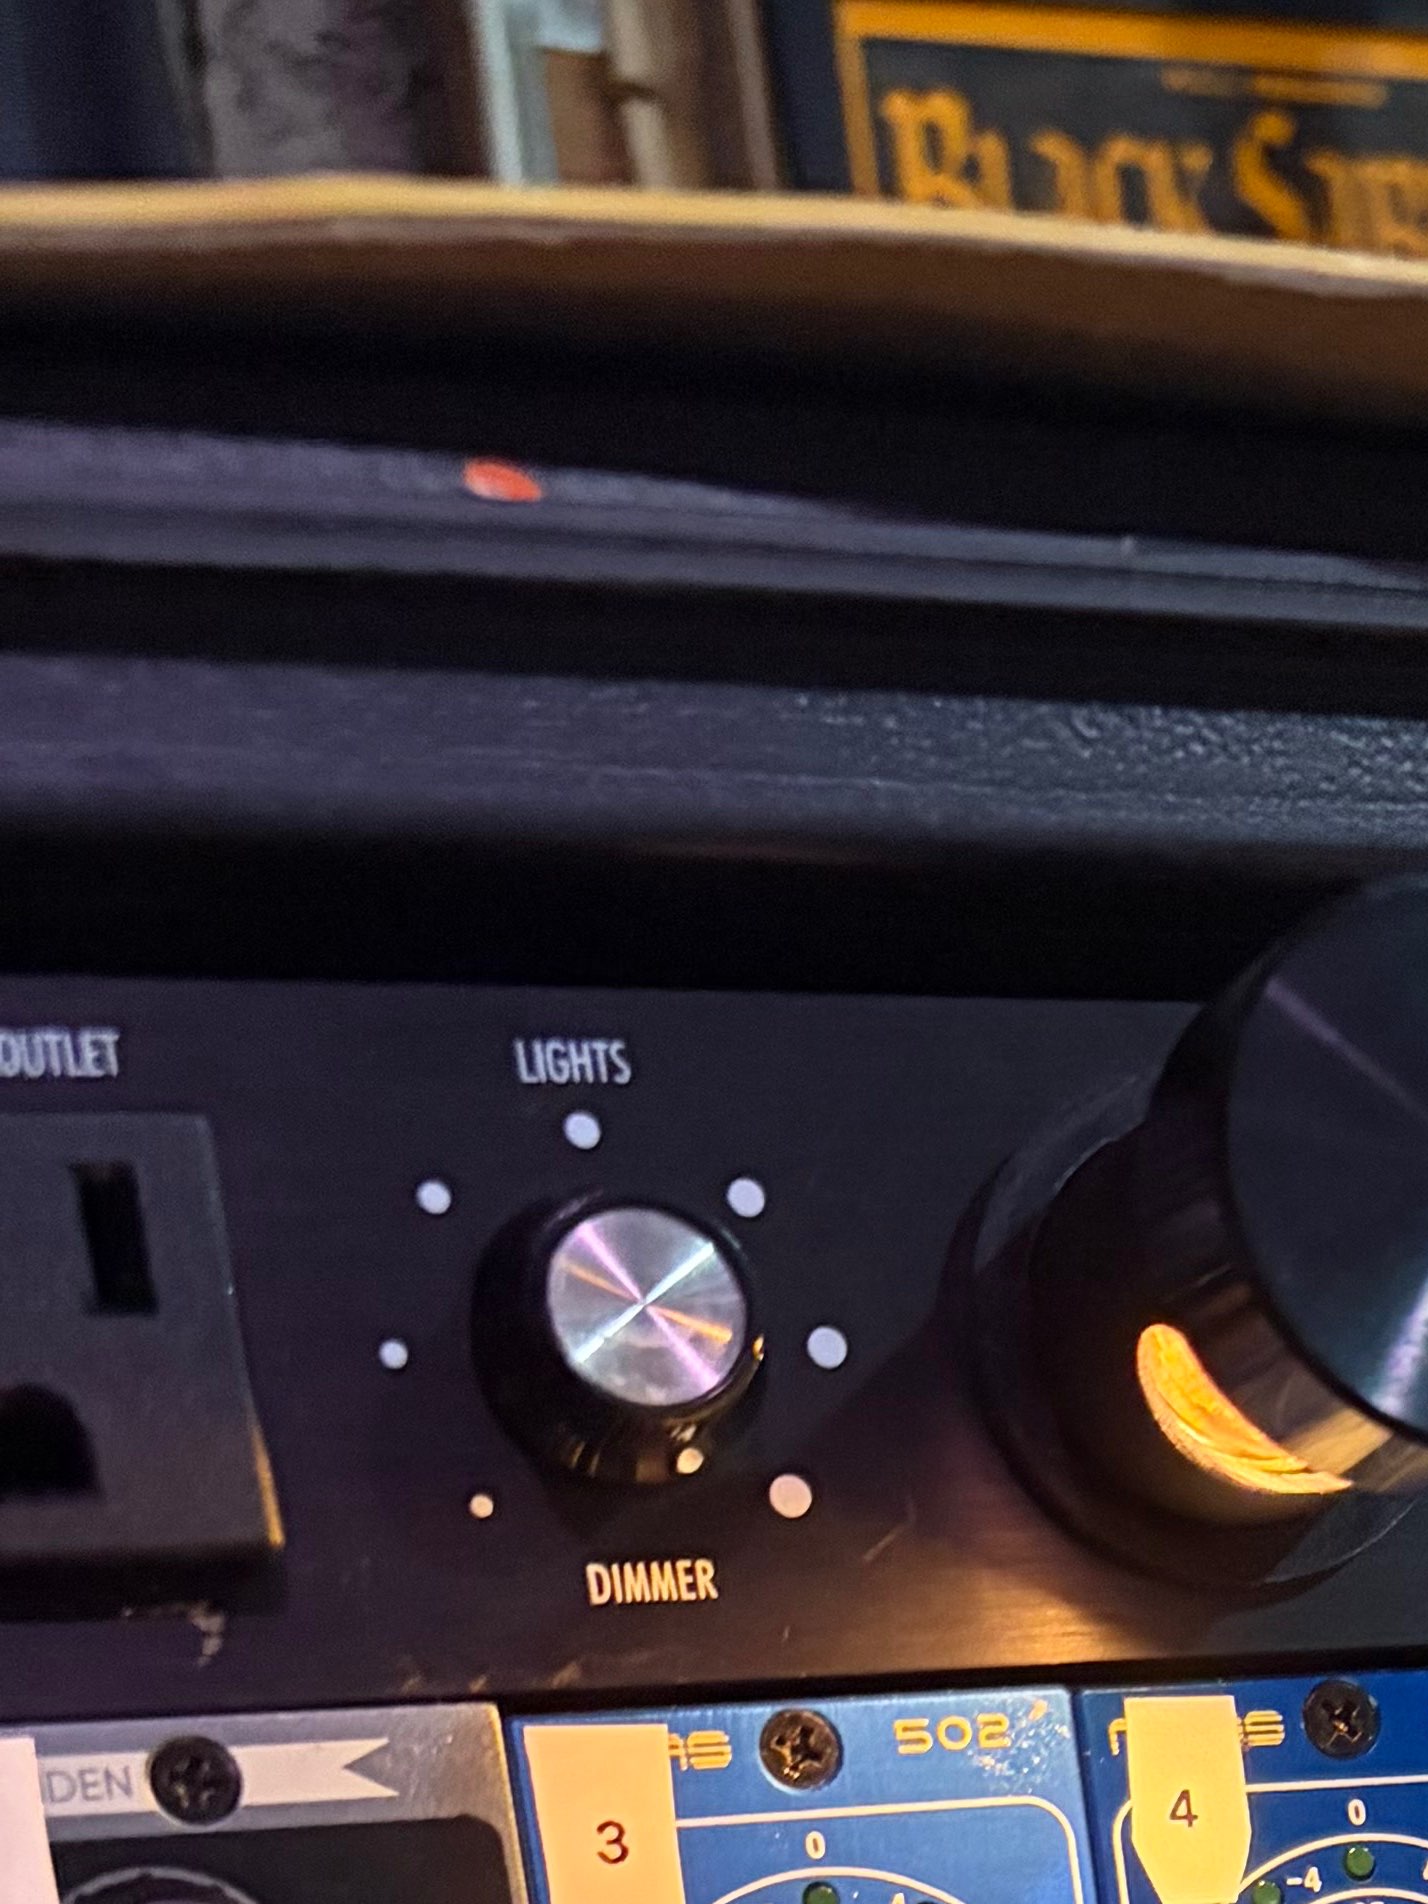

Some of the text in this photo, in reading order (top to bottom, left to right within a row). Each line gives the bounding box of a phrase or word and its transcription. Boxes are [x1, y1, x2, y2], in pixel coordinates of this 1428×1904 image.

[0, 1027, 120, 1077] OUTLET
[515, 1040, 631, 1084] LIGHTS
[586, 1559, 719, 1605] DIMMER
[893, 1714, 1012, 1756] 502
[1170, 1790, 1198, 1828] 4
[598, 1819, 630, 1865] 3
